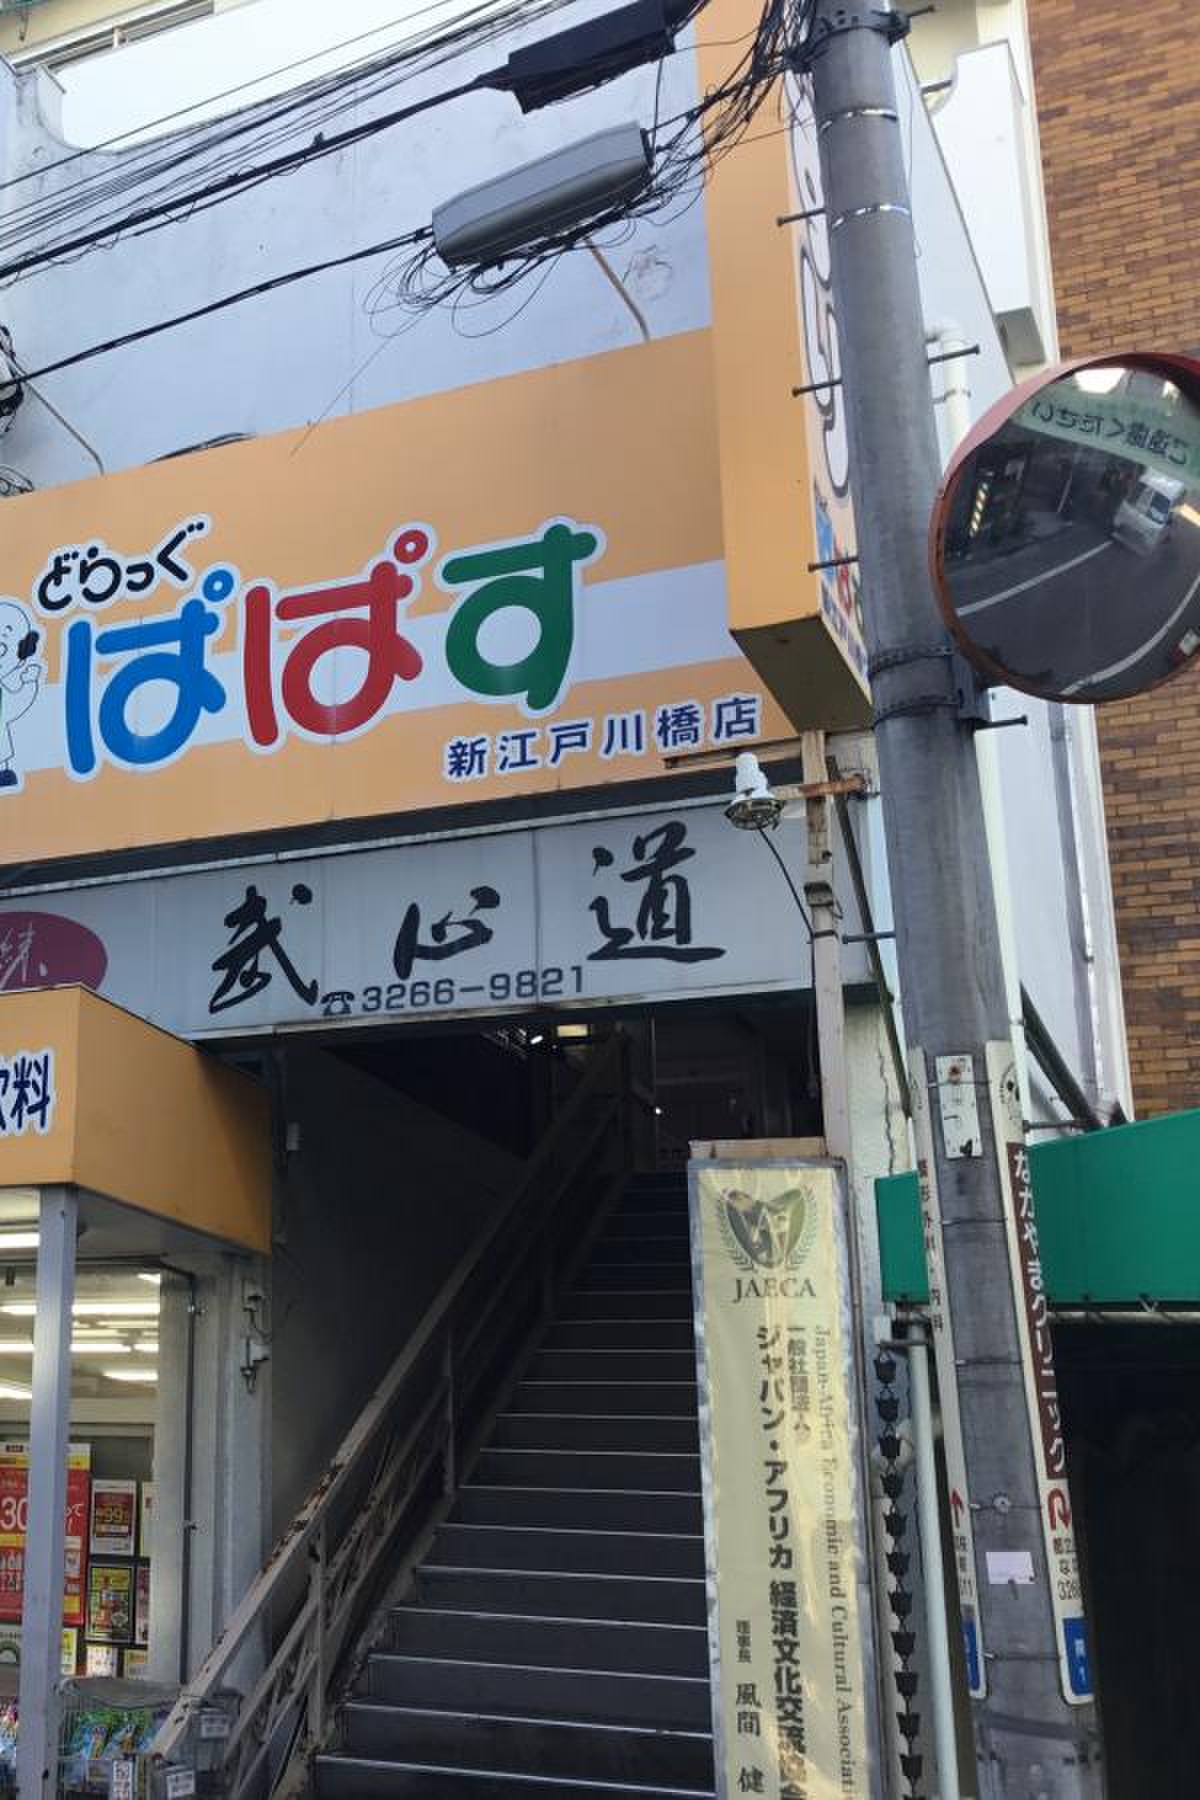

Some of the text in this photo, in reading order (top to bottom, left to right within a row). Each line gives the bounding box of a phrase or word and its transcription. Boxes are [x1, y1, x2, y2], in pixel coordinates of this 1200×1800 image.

[38, 521, 205, 611] どらっぐ
[65, 523, 598, 775] ぱぱす
[447, 696, 758, 778] 新江戸川橋店
[362, 965, 585, 1012] 3266-9821
[732, 1277, 816, 1303] JAECA
[828, 1561, 846, 1599] and
[831, 1605, 852, 1693] Cultural
